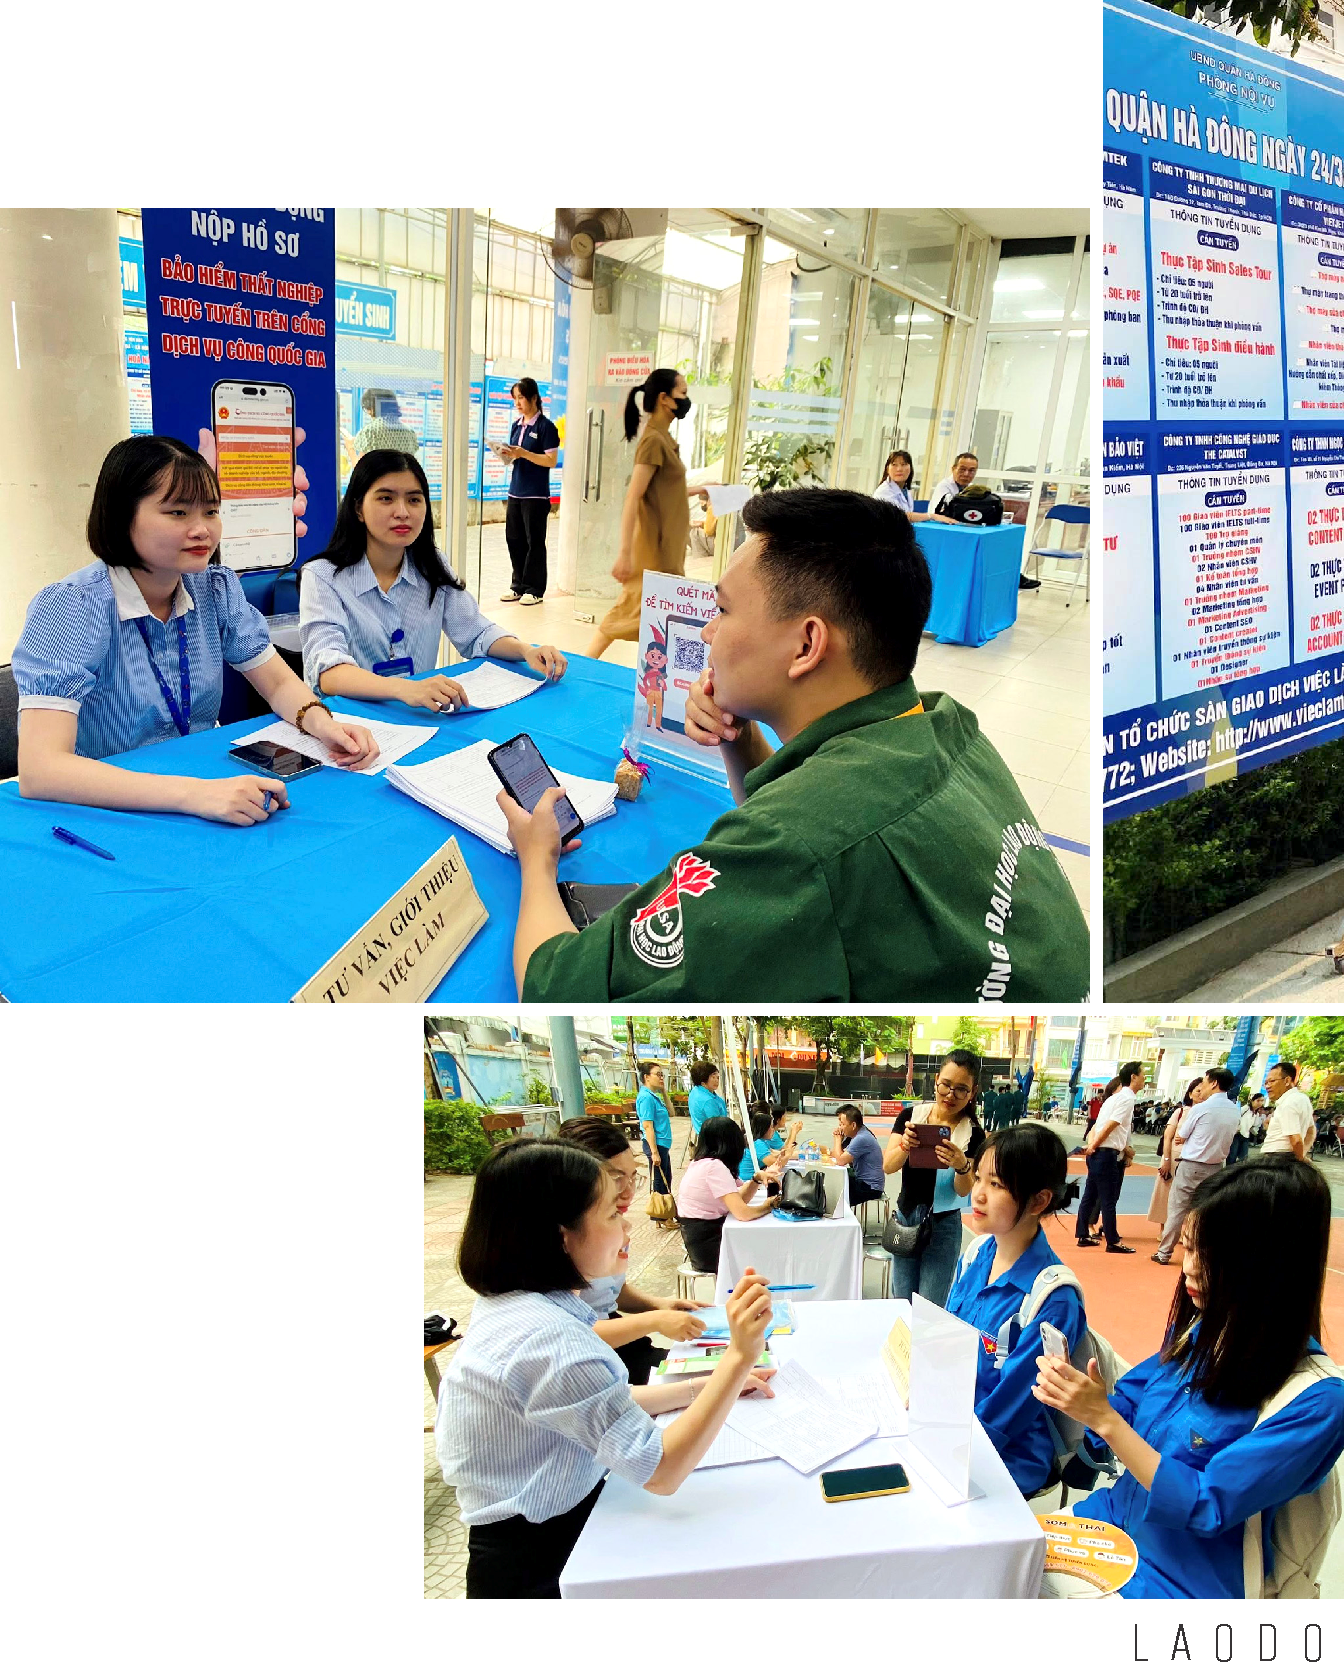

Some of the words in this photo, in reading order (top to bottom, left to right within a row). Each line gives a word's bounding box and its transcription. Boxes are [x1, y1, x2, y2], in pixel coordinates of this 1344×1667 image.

[1106, 88, 1168, 144] QUẬN
[1173, 104, 1201, 150] HÀ
[1206, 115, 1258, 165] ĐÔNG
[1262, 134, 1306, 177] NGÀY
[191, 209, 235, 246] NỘP
[242, 218, 268, 251] HỒ
[274, 231, 300, 258] SƠ
[1170, 209, 1199, 223] THÔNG
[1201, 214, 1213, 225] TIN
[1215, 217, 1239, 231] TUYỂN
[1242, 223, 1261, 235] DỤNG
[1161, 251, 1184, 269] Thực
[1187, 255, 1203, 272] Tập
[1206, 259, 1226, 274] Sinh
[1229, 262, 1252, 277] Sales
[1254, 266, 1272, 280] Tour
[161, 254, 195, 283] BẢO
[198, 261, 237, 290] HIỂM
[239, 271, 274, 296] THẤT
[277, 280, 324, 308] NGHIỆP
[160, 295, 202, 324] TRỰC
[205, 302, 251, 327] TUYẾN
[254, 309, 288, 332] TRÊN
[291, 311, 326, 337] CỔNG
[365, 302, 390, 329] SINH
[162, 333, 199, 358] DỊCH
[202, 337, 223, 362] VỤ
[226, 338, 265, 363] CÔNG
[267, 342, 303, 367] QUỐC
[305, 350, 327, 368] GIA
[1166, 335, 1189, 352] Thực
[1192, 338, 1209, 354] Tập
[1212, 339, 1232, 353] Sinh
[1109, 436, 1126, 458] BẢO
[1127, 438, 1144, 460] VIỆT
[1178, 479, 1206, 490] THÔNG
[1208, 477, 1221, 487] TIN
[1223, 471, 1247, 486] TUYỂN
[1308, 511, 1317, 525] 02
[1319, 507, 1339, 526] THỰC
[1309, 528, 1343, 546] CONTENT
[1310, 564, 1320, 579] 02
[1322, 559, 1342, 578] THỰC
[676, 585, 700, 599] QUÉT
[1314, 579, 1339, 598] EVENT
[645, 593, 657, 609] ĐỂ
[659, 598, 674, 611] TÌM
[676, 601, 698, 617] KIẾM
[1310, 616, 1320, 631] 02
[1322, 610, 1342, 629] THỰC
[1307, 630, 1343, 653] ACCOUNT
[1120, 717, 1140, 748] TỔ
[1146, 710, 1191, 742] CHỨC
[1195, 700, 1227, 727] SÀN
[1232, 690, 1264, 716] GIAO
[1269, 679, 1300, 705] DỊCH
[1303, 670, 1330, 694] VIỆC
[1140, 738, 1212, 779] Website:
[985, 883, 1013, 936] ĐẠI
[322, 967, 351, 1003] TƯ
[389, 895, 423, 937] GIỚI
[420, 855, 460, 903] THIỆU
[378, 948, 416, 996] VIỆC
[414, 911, 445, 955] LÀM
[1079, 1523, 1105, 1532] THAI
